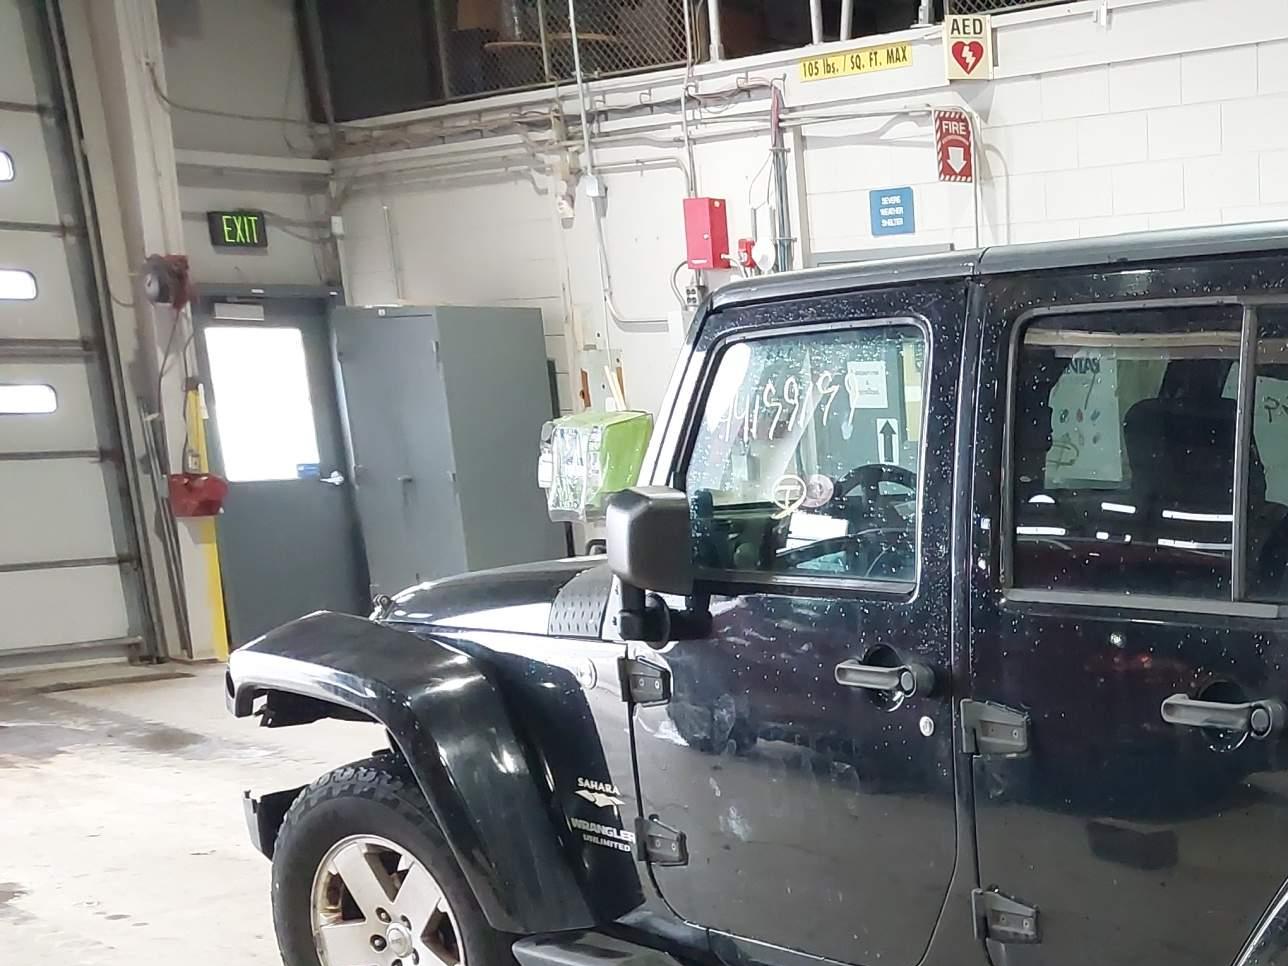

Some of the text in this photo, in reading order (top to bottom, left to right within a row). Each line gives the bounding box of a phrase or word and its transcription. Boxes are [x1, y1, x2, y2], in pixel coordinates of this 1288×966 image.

[950, 18, 983, 36] AED
[803, 61, 819, 78] 105
[822, 57, 839, 75] lbs.
[850, 54, 865, 71] SQ.
[869, 51, 882, 68] FT.
[886, 45, 908, 65] MAX
[941, 120, 967, 135] FIRE
[222, 215, 258, 244] EXIT
[577, 777, 621, 796] SAHARA
[570, 817, 636, 844] WRANGLER
[582, 833, 631, 852] UNLIMITED
